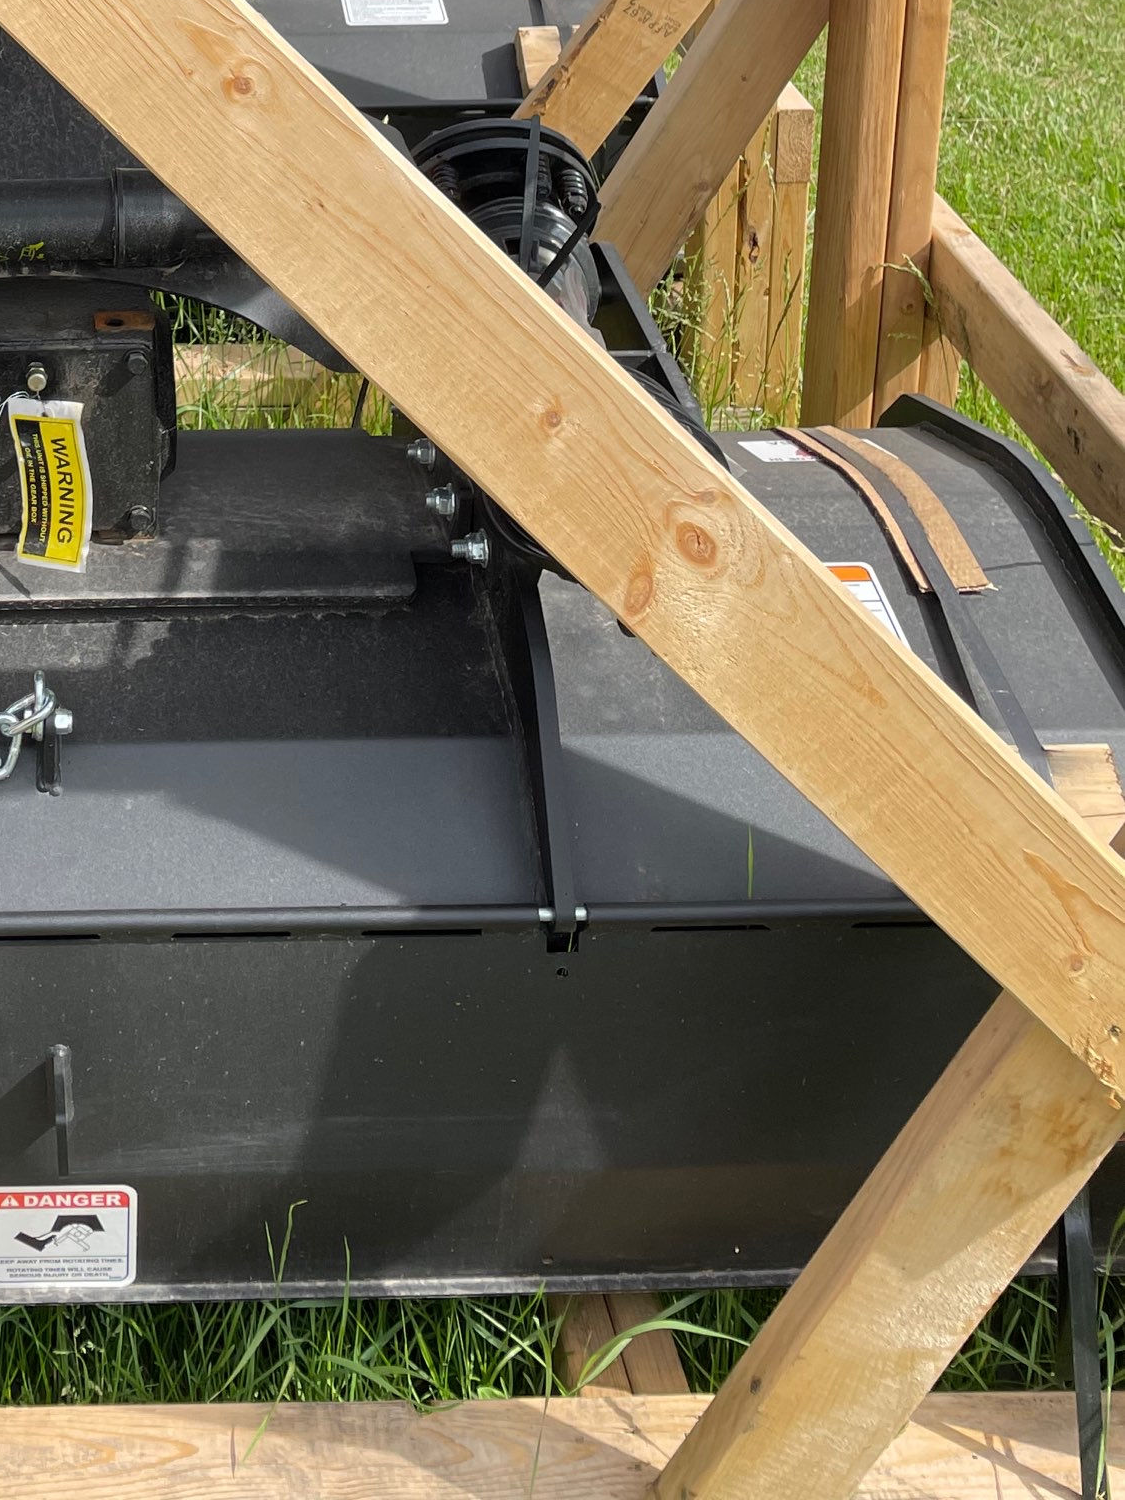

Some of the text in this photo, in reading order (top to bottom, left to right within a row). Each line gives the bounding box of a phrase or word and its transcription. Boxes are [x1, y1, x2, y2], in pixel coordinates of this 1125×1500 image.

[32, 433, 40, 448] THIS
[35, 449, 44, 465] UNIT
[28, 469, 36, 482] THE
[39, 475, 48, 506] SHIPPED
[50, 437, 75, 544] WARNING
[38, 507, 48, 542] WITHOUT
[23, 1193, 122, 1207] DANGER
